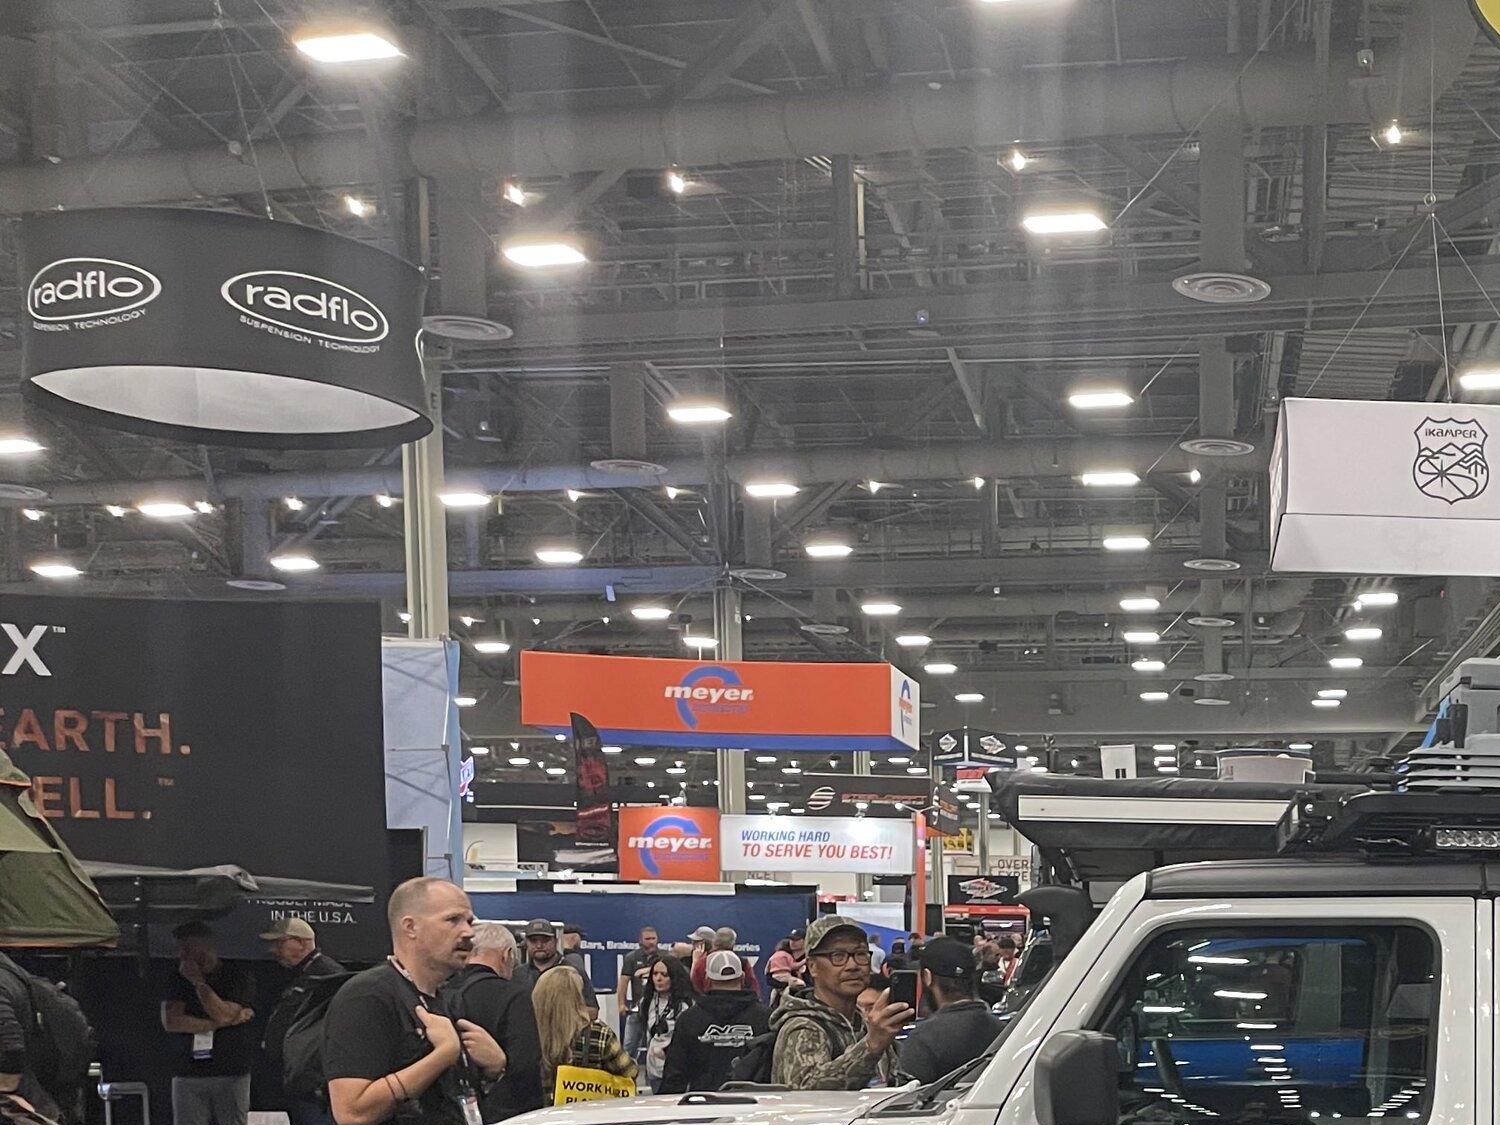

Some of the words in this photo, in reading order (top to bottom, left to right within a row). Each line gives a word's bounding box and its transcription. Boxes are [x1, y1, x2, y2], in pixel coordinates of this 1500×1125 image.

[34, 271, 144, 308] radflo
[246, 284, 378, 332] radflo
[75, 309, 146, 329] TECHNOLOGY
[240, 315, 312, 344] SUSPENSION
[319, 339, 380, 354] TECHNOLOGY
[664, 686, 754, 704] meyer
[0, 707, 191, 754] ARTH.
[628, 836, 712, 853] meyer
[741, 830, 796, 842] WORKING
[798, 831, 830, 842] HARD
[742, 844, 762, 857] TO
[765, 844, 812, 858] SERVE
[818, 845, 846, 859] YOU
[850, 846, 893, 859] BEST!
[997, 859, 1029, 869] OVER
[271, 910, 285, 921] IN
[580, 941, 605, 950] Bars,
[563, 1081, 602, 1093] WORK
